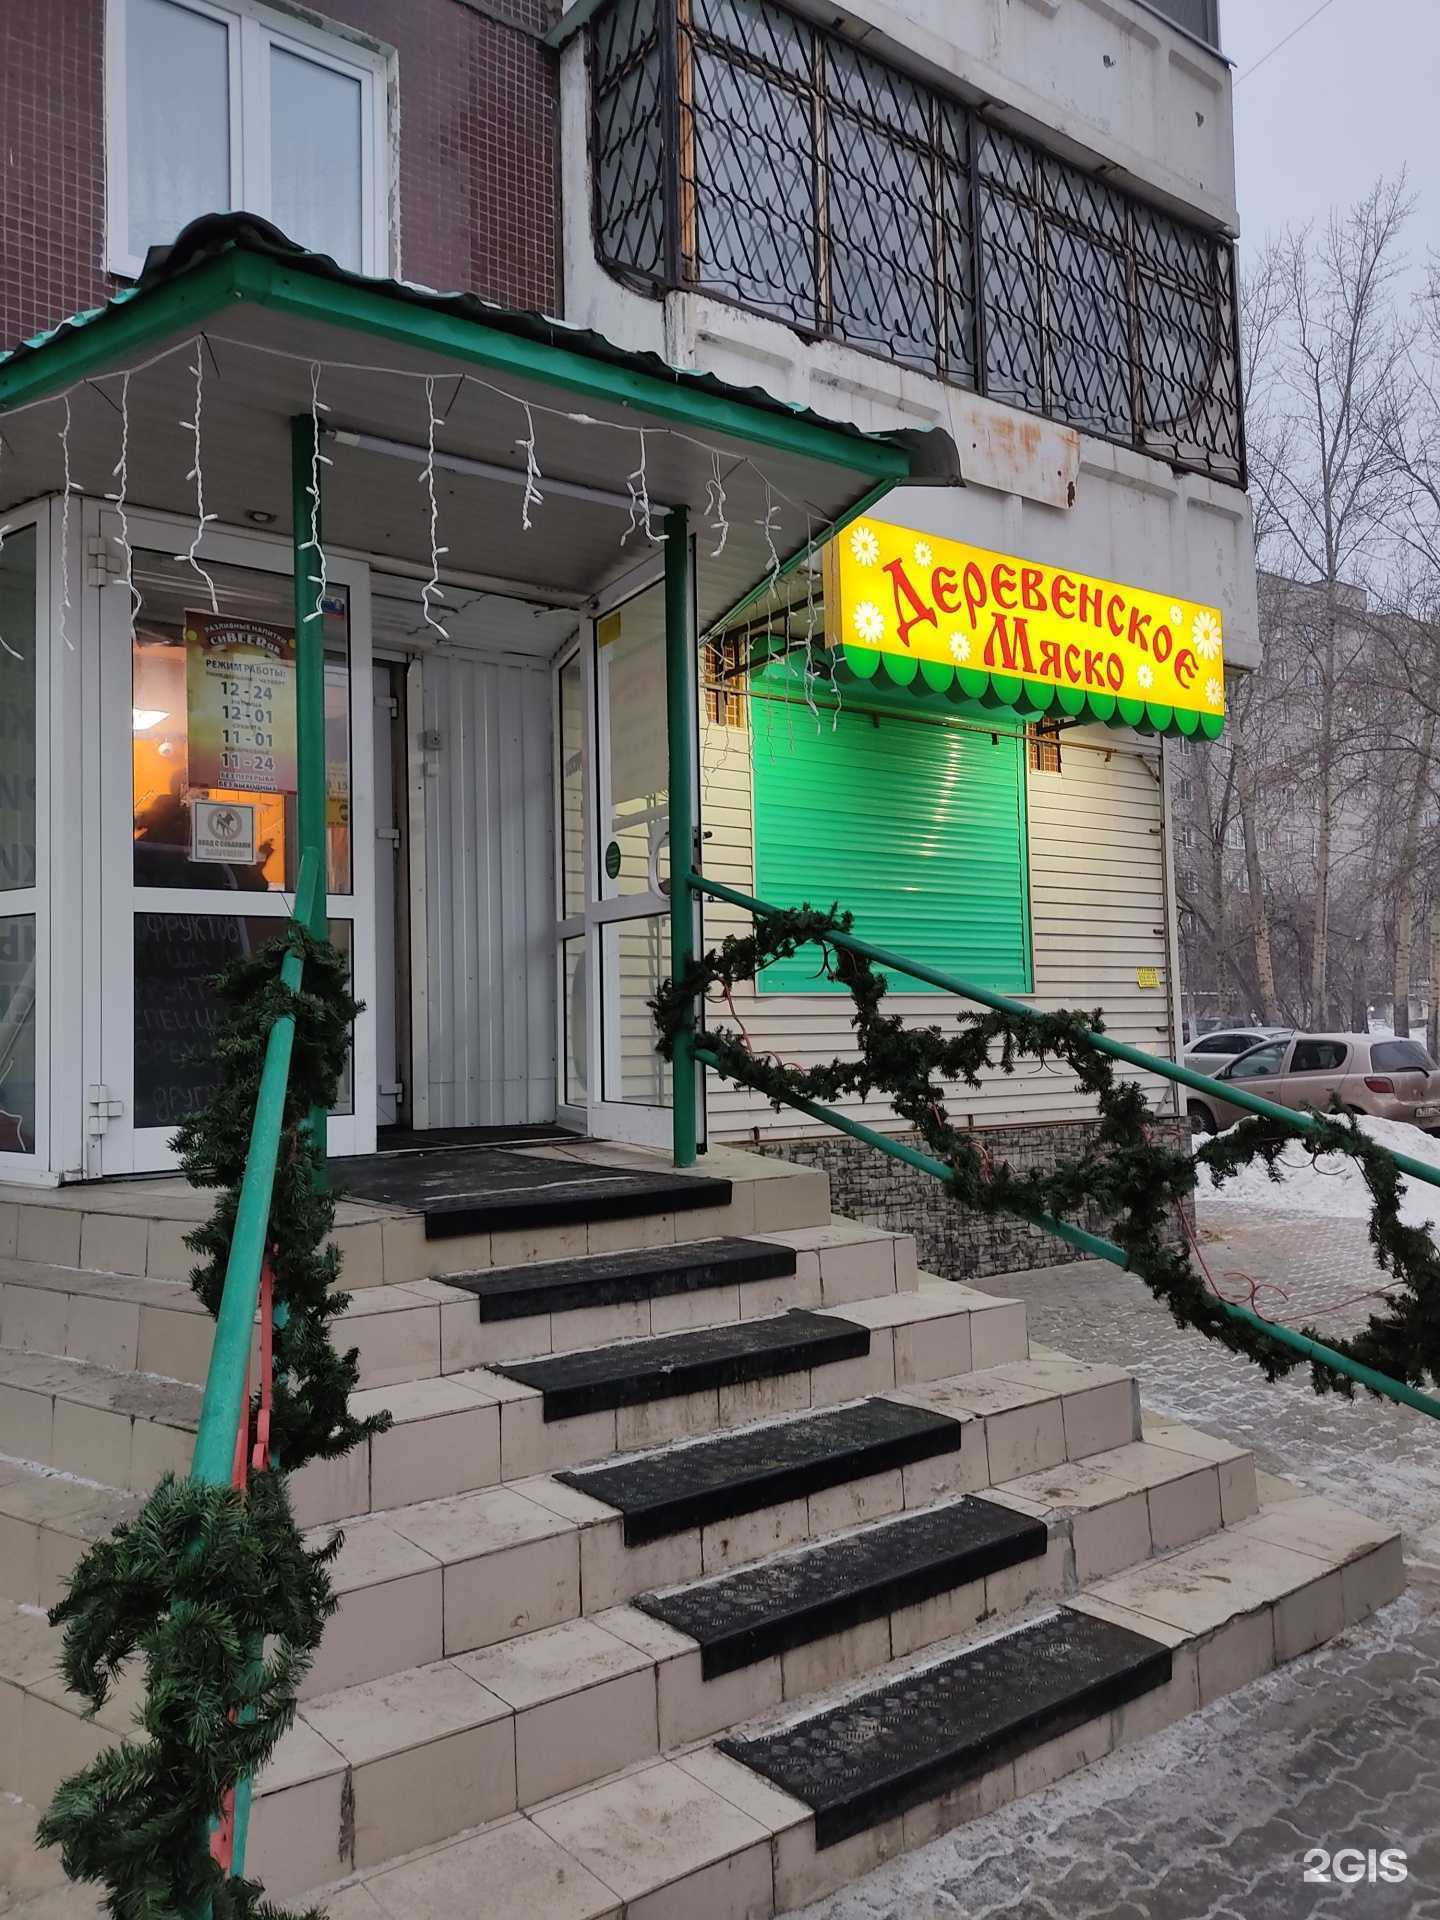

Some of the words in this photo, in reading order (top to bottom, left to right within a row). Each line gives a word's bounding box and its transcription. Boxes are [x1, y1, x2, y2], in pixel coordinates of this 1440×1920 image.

[983, 612, 1124, 691] Мяско
[206, 660, 242, 674] РЕЖИМ
[221, 681, 240, 697] 12
[253, 685, 273, 700] 24
[222, 705, 241, 720] 12
[255, 709, 273, 723] 01
[222, 729, 240, 744] 11
[255, 732, 273, 747] 01
[222, 753, 240, 768] 11
[254, 756, 273, 770] 24
